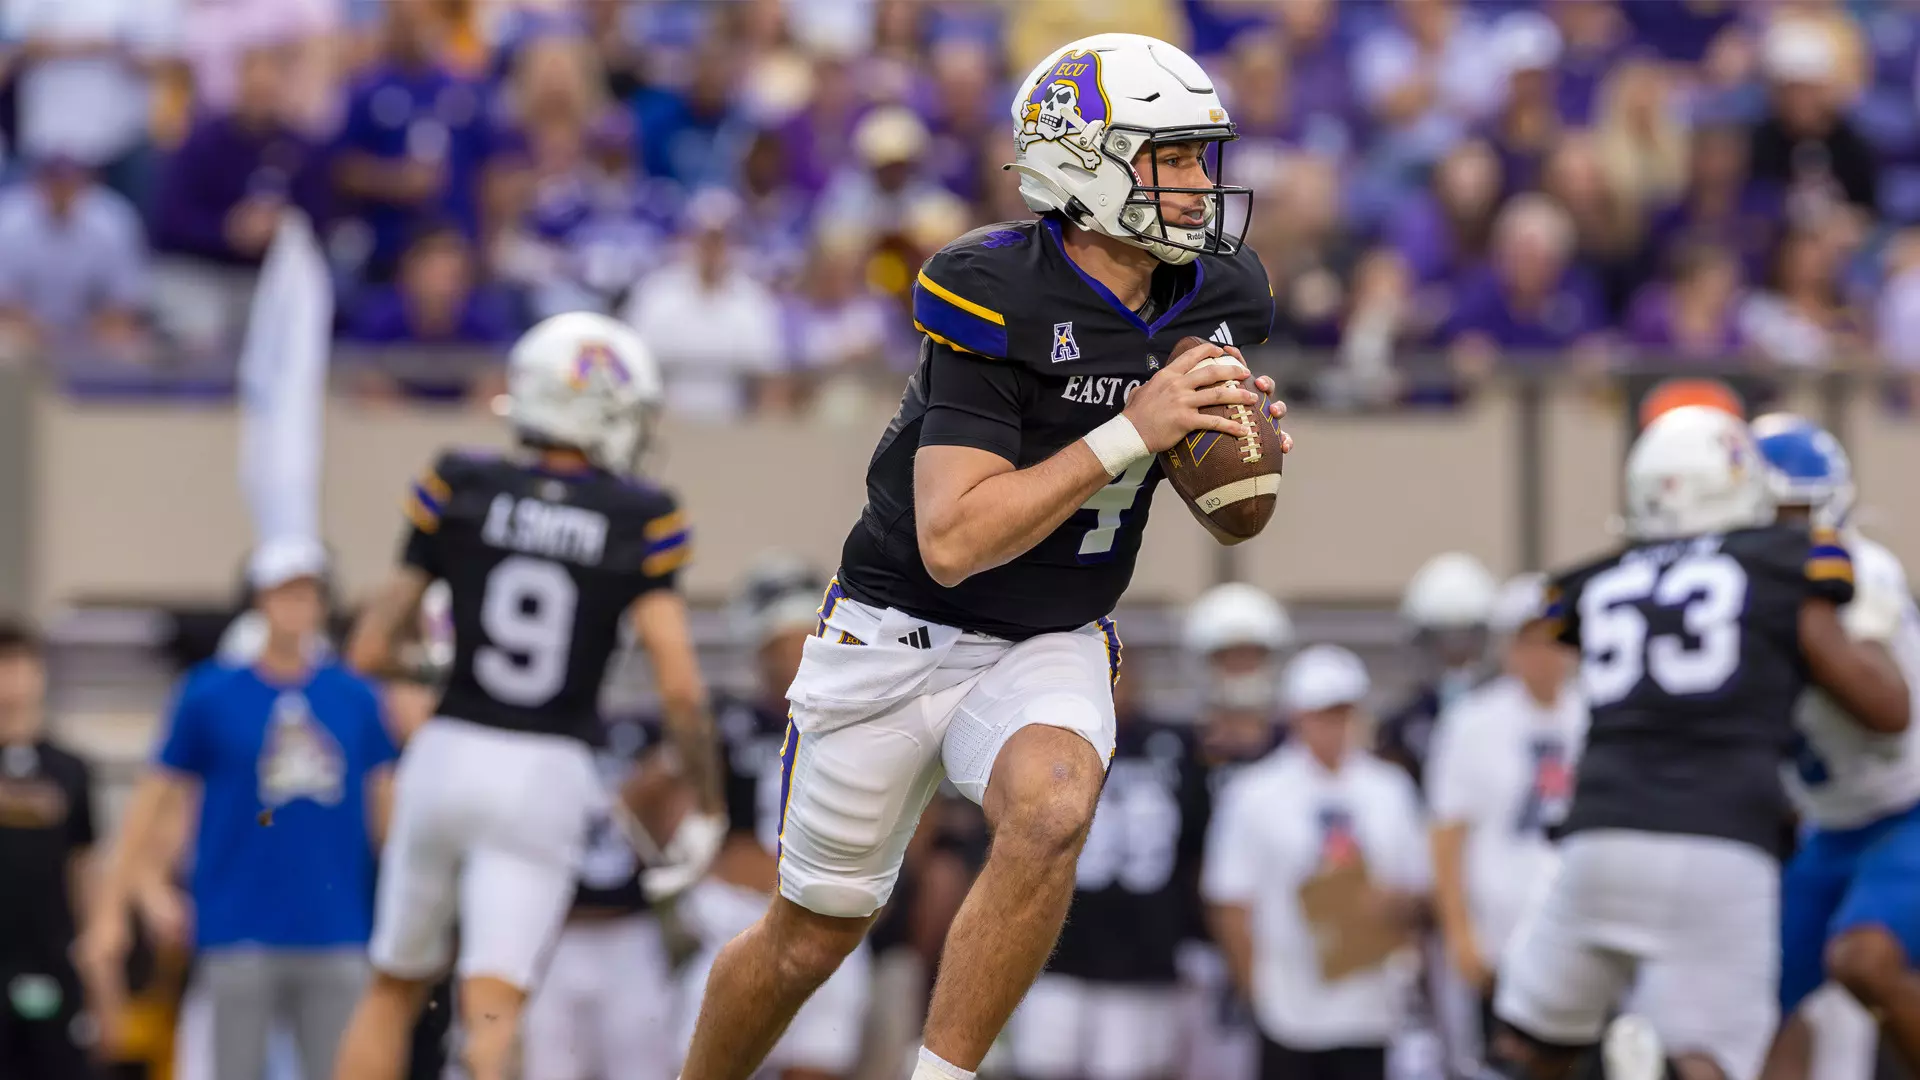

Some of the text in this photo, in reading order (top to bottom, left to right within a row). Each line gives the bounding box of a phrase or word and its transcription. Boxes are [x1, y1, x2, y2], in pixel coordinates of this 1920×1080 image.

[1054, 62, 1090, 77] ECU
[1061, 375, 1123, 406] EAST
[1205, 496, 1221, 509] QB
[472, 553, 579, 708] 9
[1577, 551, 1748, 707] 53
